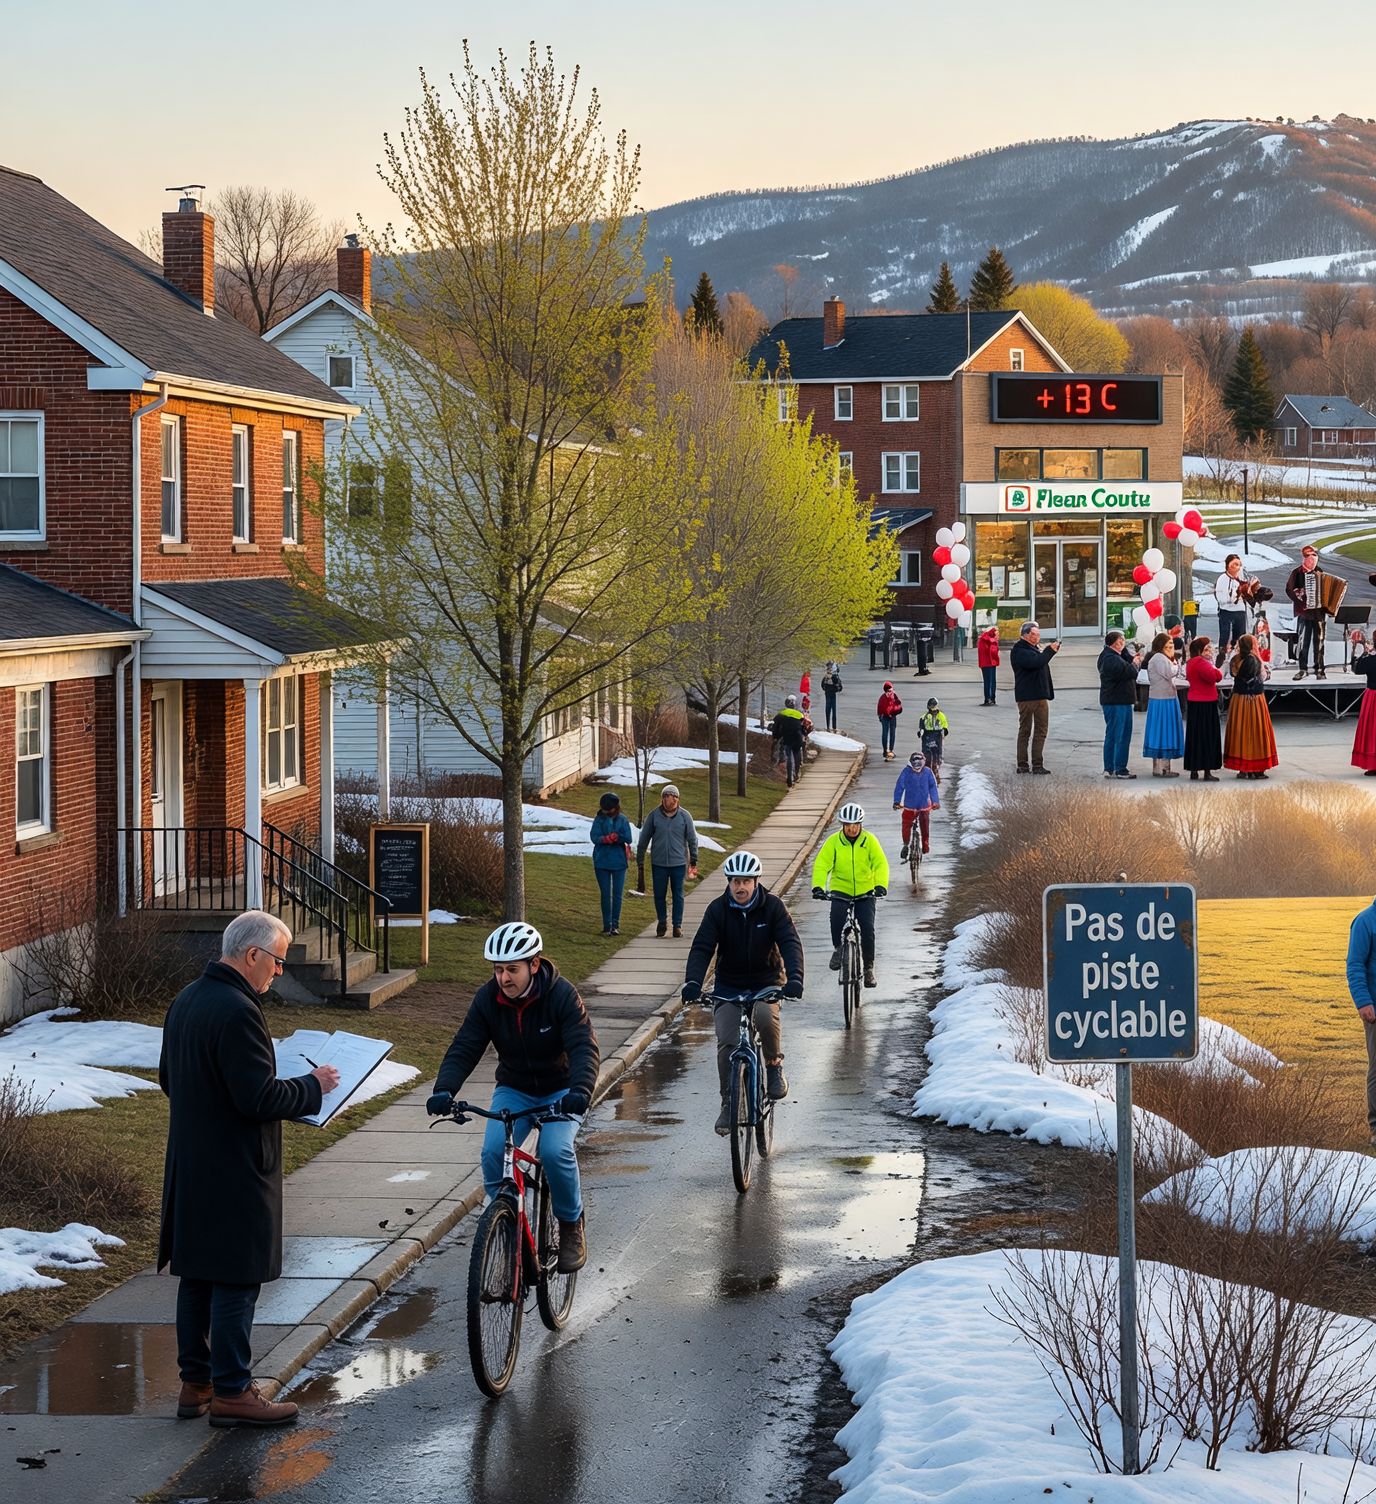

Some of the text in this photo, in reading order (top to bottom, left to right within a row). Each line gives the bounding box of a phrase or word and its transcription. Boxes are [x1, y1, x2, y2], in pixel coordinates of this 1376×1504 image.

[1065, 902, 1176, 942] Pas de
[1082, 952, 1160, 999] piste
[1054, 1000, 1187, 1049] cyclable
